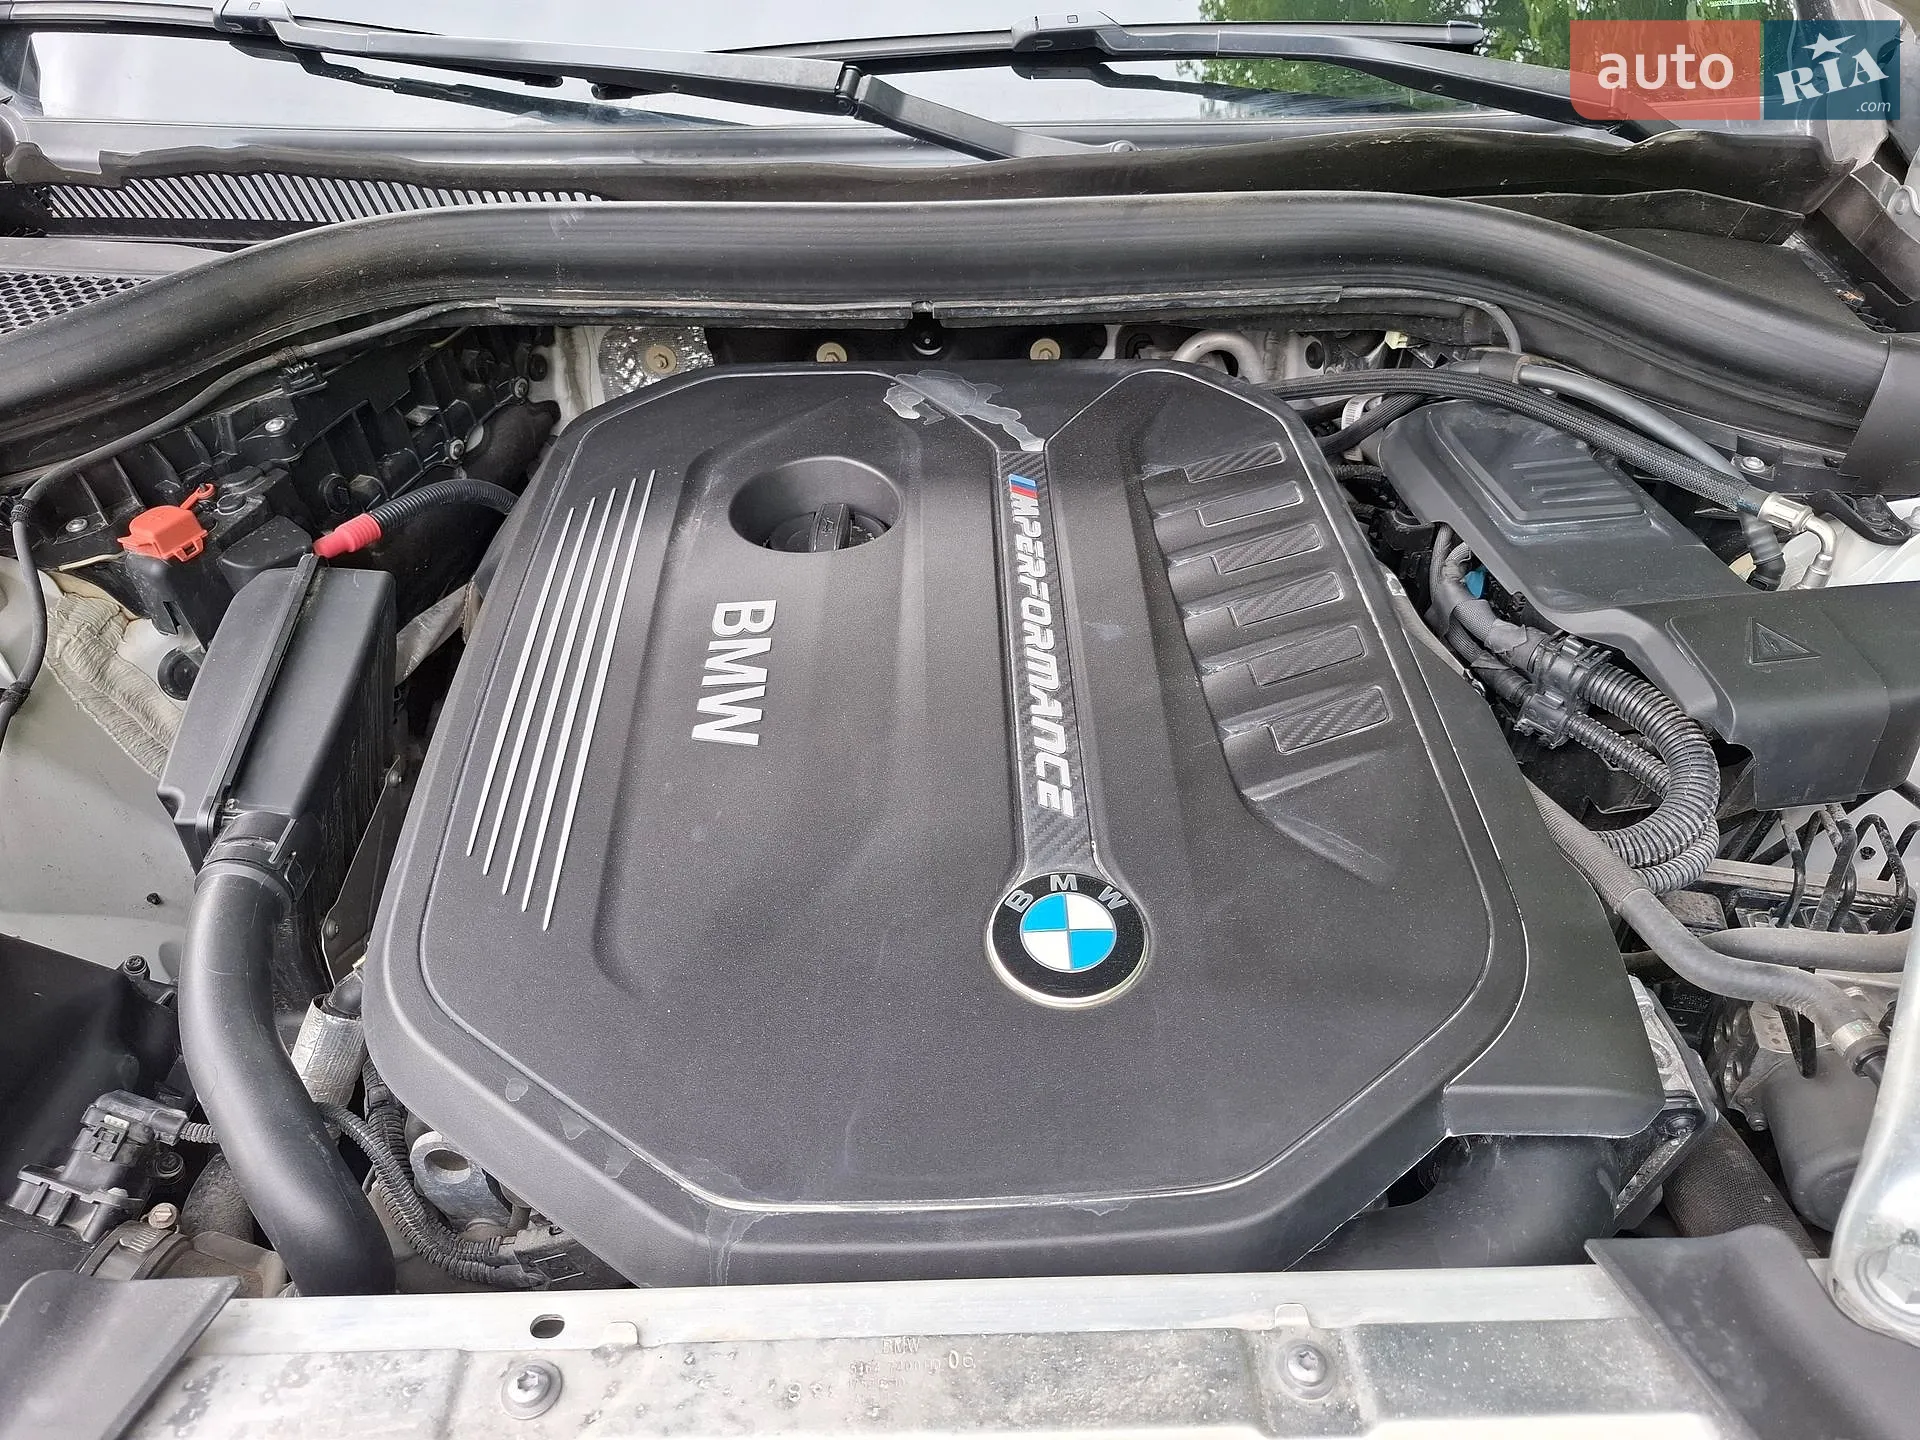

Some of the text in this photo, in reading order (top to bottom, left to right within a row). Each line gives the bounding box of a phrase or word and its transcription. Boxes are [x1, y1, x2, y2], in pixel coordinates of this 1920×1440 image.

[691, 600, 777, 746] BMW
[1013, 515, 1075, 819] PERFORMANCE
[1004, 873, 1129, 914] BMW
[881, 1337, 920, 1355] BMW
